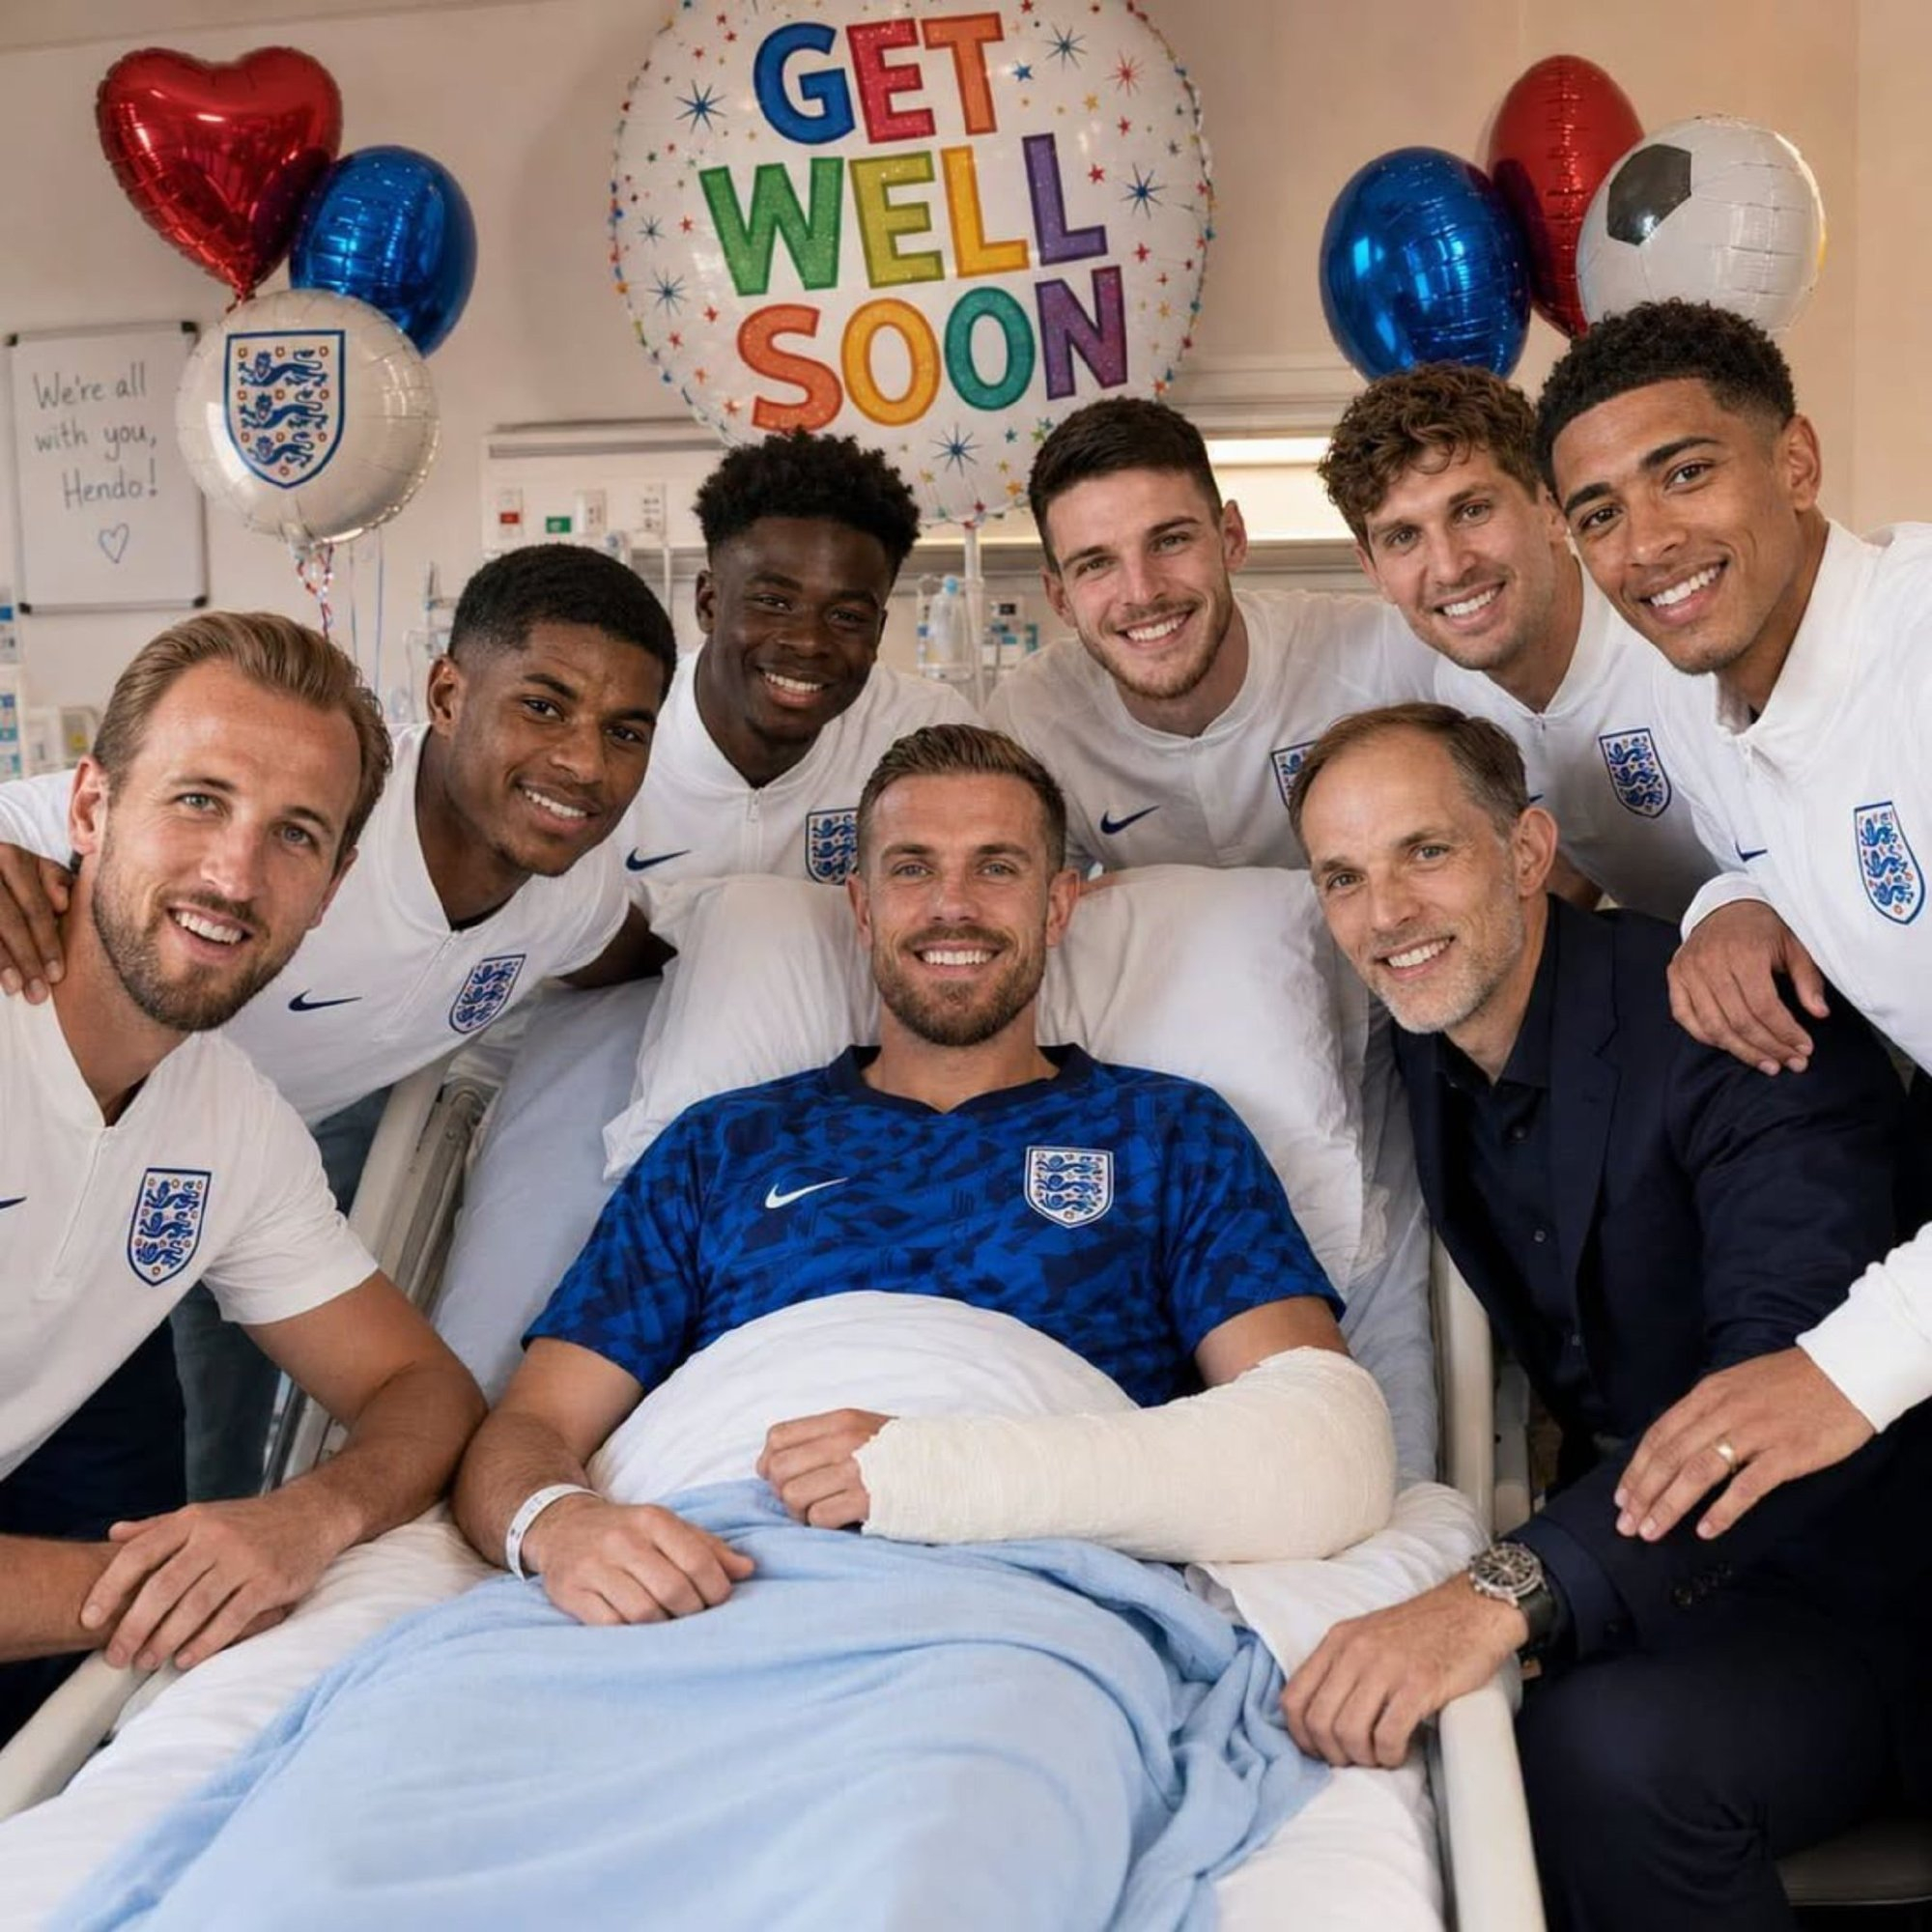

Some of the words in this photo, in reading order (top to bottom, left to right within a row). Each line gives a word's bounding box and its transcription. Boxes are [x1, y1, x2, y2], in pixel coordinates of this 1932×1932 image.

[753, 12, 1004, 145] GET
[698, 132, 1108, 297] WELL
[34, 371, 103, 409] We're
[116, 361, 147, 399] all
[736, 265, 1128, 433] SOON
[36, 418, 89, 452] with
[103, 425, 157, 460] you,
[63, 458, 157, 508] Hendo!
